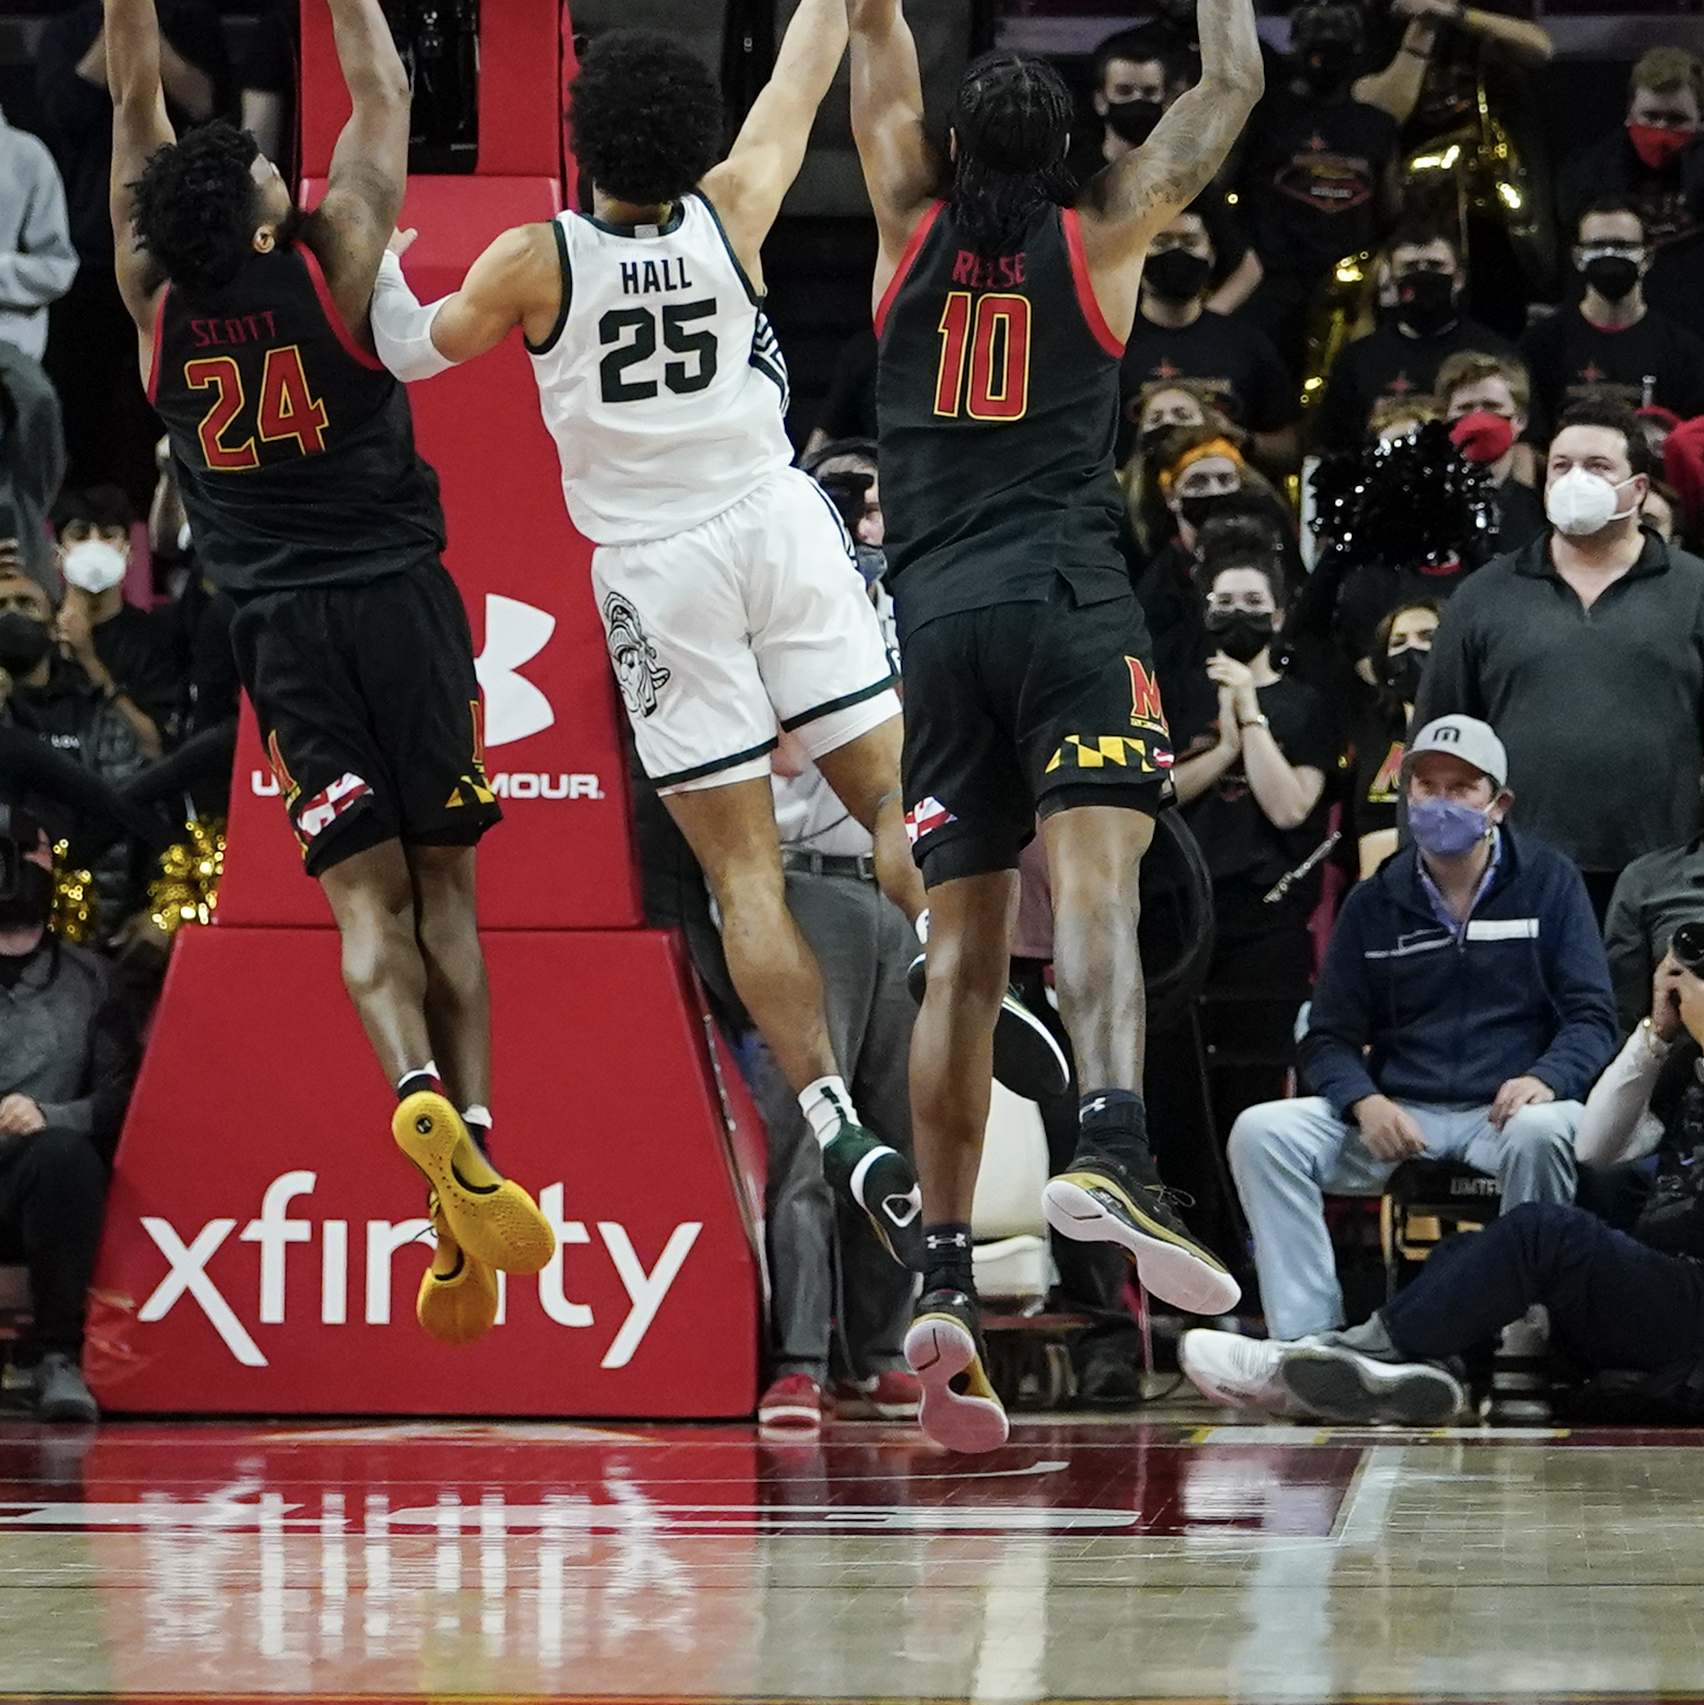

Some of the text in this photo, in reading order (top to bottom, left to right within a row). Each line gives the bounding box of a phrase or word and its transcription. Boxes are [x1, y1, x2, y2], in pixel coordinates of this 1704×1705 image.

[190, 310, 277, 347] SCOTT
[619, 257, 693, 295] HALL
[183, 344, 330, 471] 24
[598, 297, 719, 404] 25
[933, 291, 1032, 422] 10
[137, 1170, 704, 1369] xfinty
